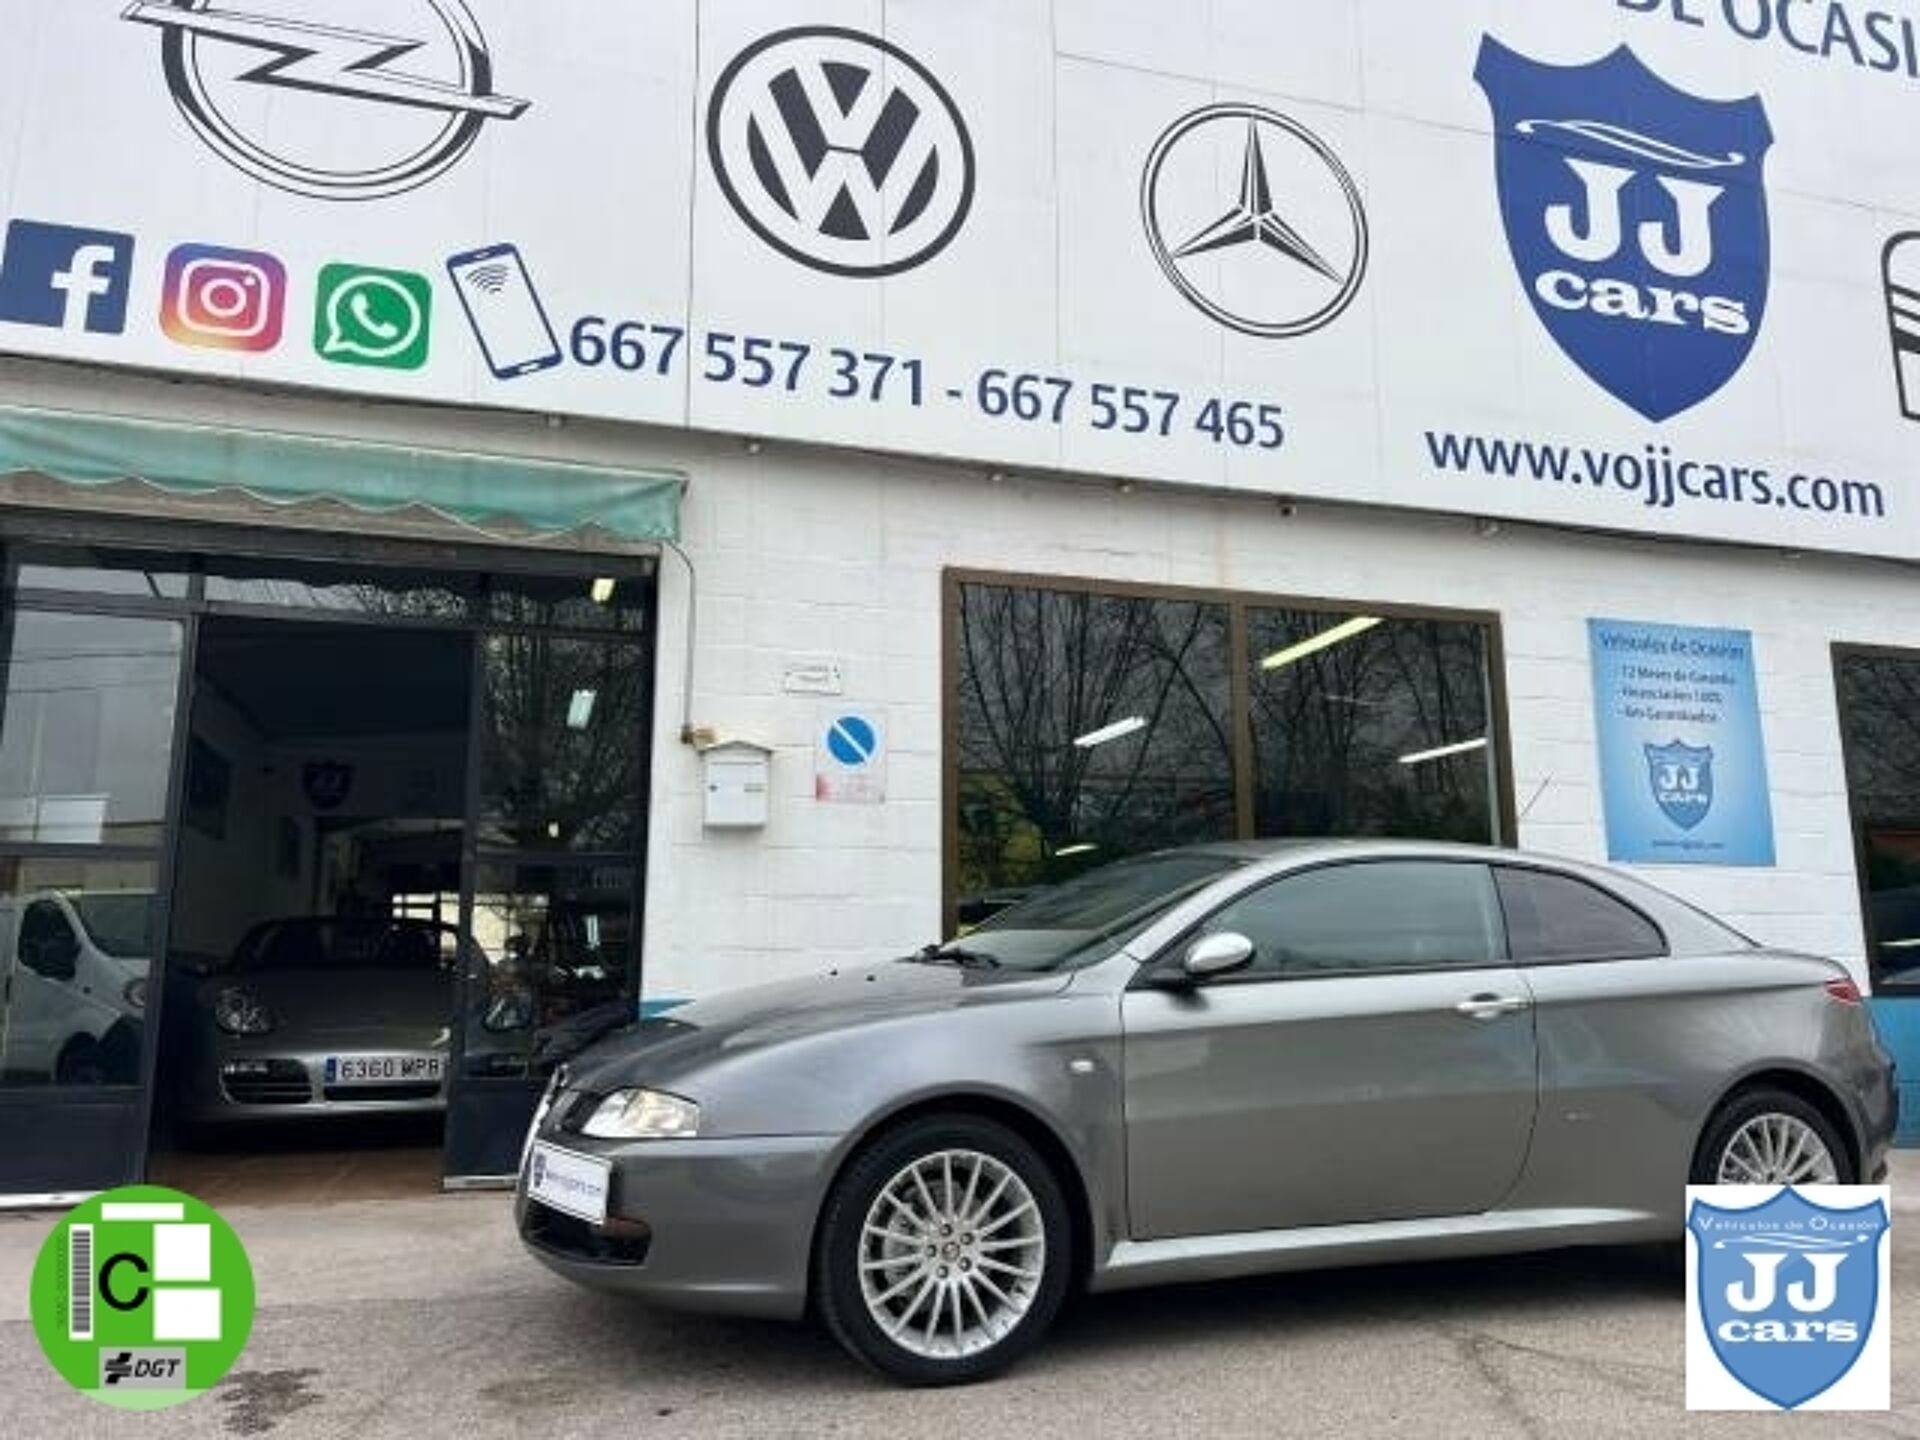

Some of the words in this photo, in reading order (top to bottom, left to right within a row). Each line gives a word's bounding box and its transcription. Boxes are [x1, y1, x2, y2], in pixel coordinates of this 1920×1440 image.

[1544, 157, 1726, 278] JJ
[1534, 269, 1751, 335] cars
[569, 315, 685, 375] 667
[703, 331, 811, 391] 557
[828, 347, 923, 406] 371
[976, 368, 1073, 424] 667
[1090, 383, 1180, 436] 557
[1195, 397, 1285, 449] 465
[1424, 430, 1885, 518] www.vojjcars.com
[1659, 763, 1699, 790] JJ
[341, 1059, 394, 1078] 6360
